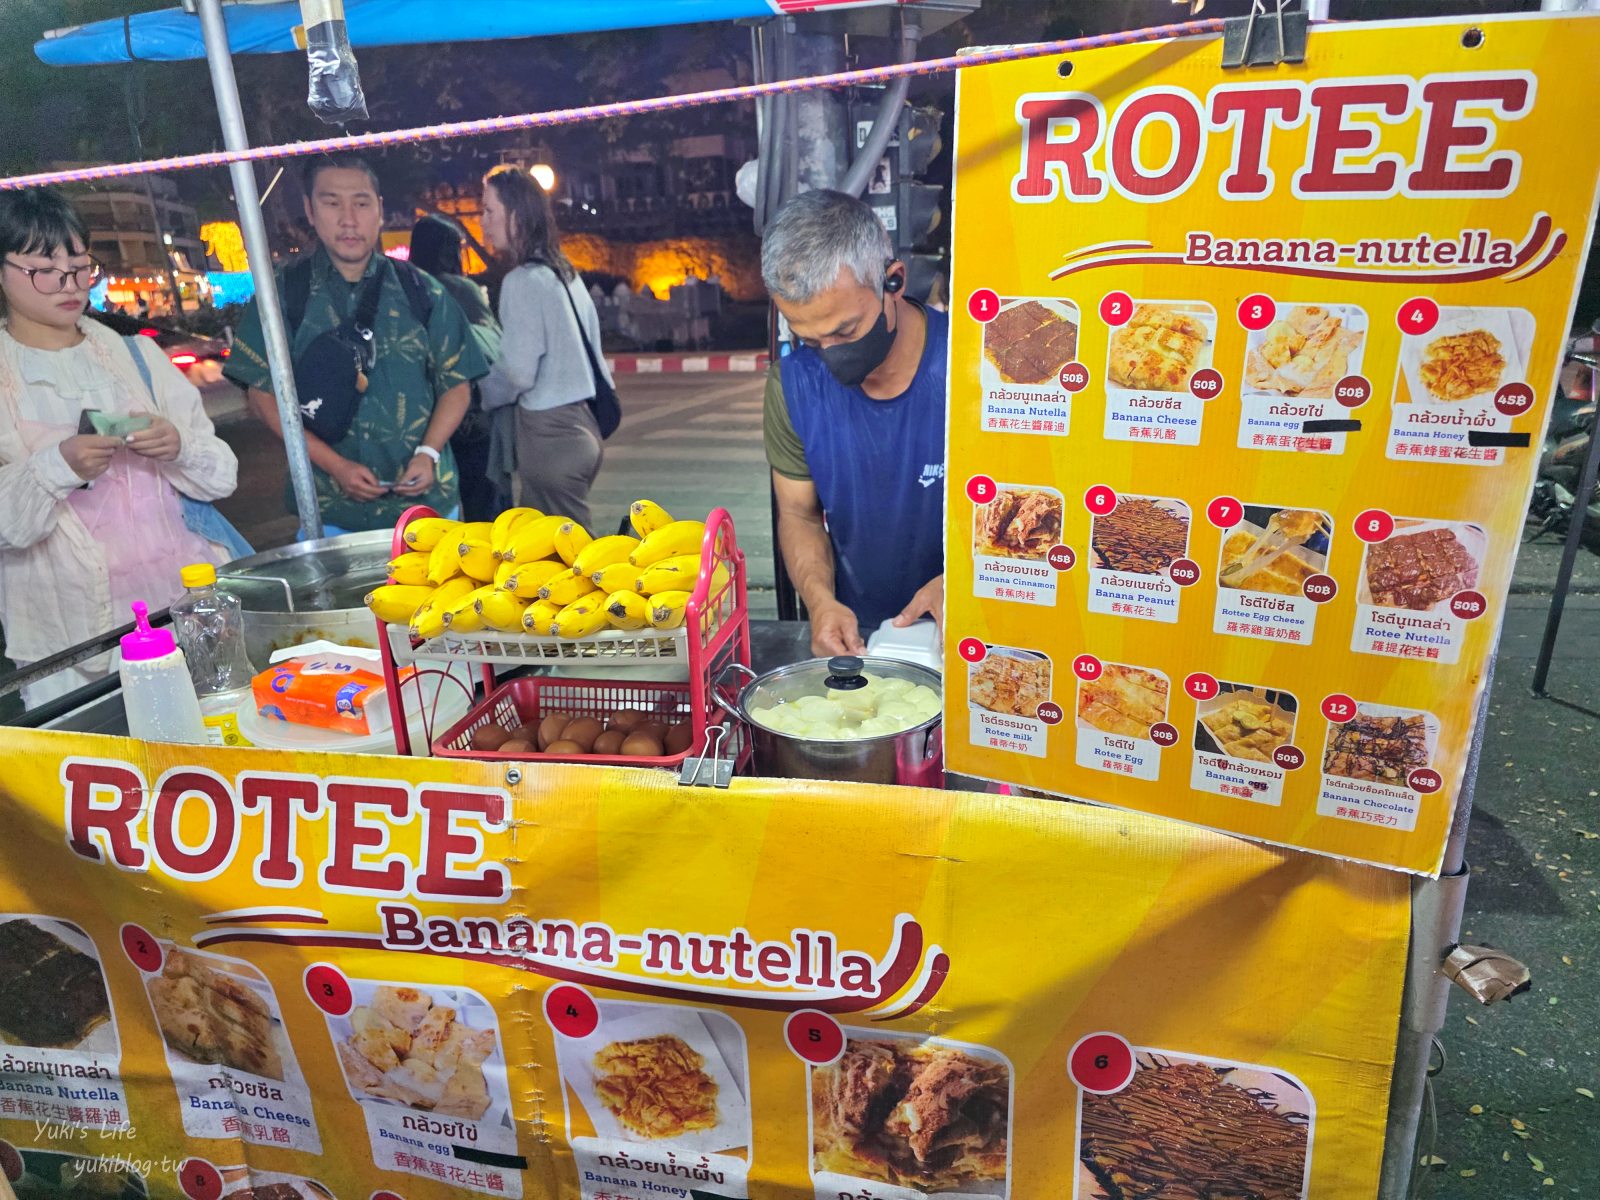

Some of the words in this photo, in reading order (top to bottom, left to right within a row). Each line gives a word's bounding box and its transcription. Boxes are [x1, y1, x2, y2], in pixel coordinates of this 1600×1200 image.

[1015, 77, 1530, 199] ROTEE
[1187, 232, 1514, 265] Banana-nutella
[980, 299, 988, 311] 1
[1110, 302, 1121, 315] 2
[1251, 305, 1262, 318] 3
[1411, 309, 1424, 323] 4
[1062, 373, 1084, 384] 50฿
[1193, 380, 1217, 391] 50฿
[1338, 386, 1364, 398] 50฿
[1129, 395, 1182, 410] กล้วยชีส
[1497, 394, 1526, 407] 45฿
[987, 405, 1025, 415] Banana
[1029, 406, 1067, 417] Nutella
[1269, 403, 1324, 417] กล้วยไข่
[1111, 412, 1153, 423] Banana
[1156, 415, 1197, 426] Cheese
[1247, 418, 1280, 427] Banana
[1283, 421, 1300, 430] egg
[1129, 426, 1176, 440] 香蕉乳酪
[1393, 428, 1430, 438] Banana
[1433, 431, 1465, 441] Honey
[977, 484, 986, 495] 5
[1095, 494, 1105, 506] 6
[1219, 506, 1230, 518] 7
[1368, 520, 1380, 532] 8
[979, 574, 1010, 584] Banana
[1012, 578, 1056, 590] Cinnamon
[995, 587, 1036, 600] 香蕉肉桂
[1095, 588, 1134, 600] Banana
[1137, 594, 1175, 606] Peanut
[1111, 602, 1156, 617] 香蕉花生
[1221, 608, 1250, 617] Rottee
[1253, 612, 1270, 622] Egg
[1272, 615, 1305, 625] Cheese
[1365, 627, 1401, 639] Rotee
[1405, 632, 1451, 645] Nutella
[967, 646, 976, 656] 9
[1079, 661, 1096, 673] 10
[1194, 681, 1208, 693] 11
[1329, 703, 1347, 716] 12
[985, 727, 1011, 738] Rotee
[1013, 732, 1033, 742] milk
[1094, 748, 1122, 760] Rotee
[1125, 754, 1144, 766] Egg
[1205, 770, 1245, 784] Banana
[1322, 791, 1360, 804] Banana
[1363, 799, 1414, 813] Chocolate
[1335, 806, 1398, 826] 香蕉巧克力
[63, 761, 506, 899] ROTEE
[137, 939, 148, 954] 2
[379, 904, 878, 994] Banana-nutella
[323, 983, 335, 997] 3
[565, 1004, 579, 1018] 4
[808, 1028, 821, 1042] 5
[0, 1054, 112, 1081] ล้วยนูเทลล่า
[1094, 1055, 1109, 1069] 6
[57, 1085, 120, 1101] Nutella
[253, 1106, 311, 1128] Cheese
[402, 1115, 478, 1142] กล้วยไข่
[379, 1128, 424, 1148] Banana
[427, 1143, 450, 1156] egg
[584, 1171, 637, 1188] Banana
[642, 1179, 688, 1198] Honey
